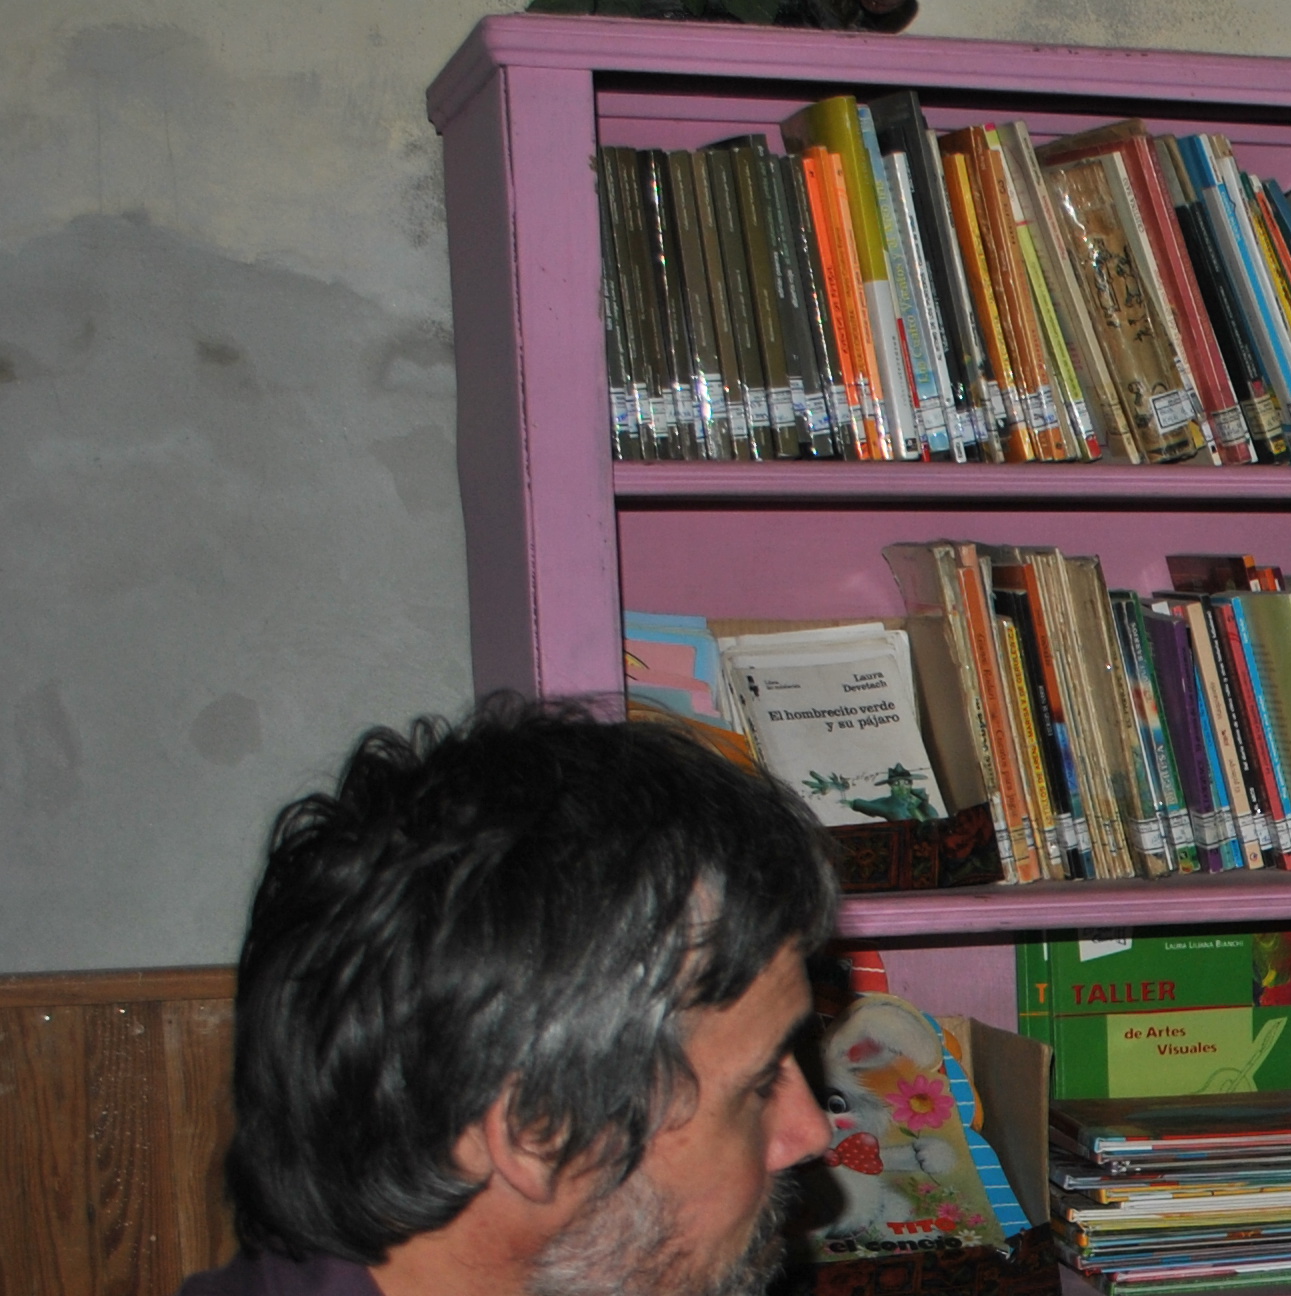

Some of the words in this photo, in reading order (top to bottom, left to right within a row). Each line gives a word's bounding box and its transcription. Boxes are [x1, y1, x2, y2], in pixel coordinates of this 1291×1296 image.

[890, 262, 913, 312] Vientos
[902, 313, 924, 359] Cuatro
[1128, 621, 1145, 661] BARRIOS
[842, 678, 887, 693] Devetach
[853, 670, 884, 682] Laura
[768, 710, 783, 722] El
[785, 705, 858, 722] hombrecito
[860, 700, 895, 713] verde
[826, 720, 834, 732] y
[838, 718, 855, 729] su
[859, 712, 900, 730] pájaro
[1021, 706, 1034, 738] MARISA
[1034, 772, 1044, 784] DE
[1071, 980, 1177, 1006] TALLER
[1124, 1026, 1143, 1039] de
[1146, 1025, 1186, 1039] Artes
[1157, 1042, 1217, 1055] Visuales
[886, 1218, 957, 1236] TITO
[829, 1238, 856, 1252] el
[863, 1234, 962, 1255] conejo
